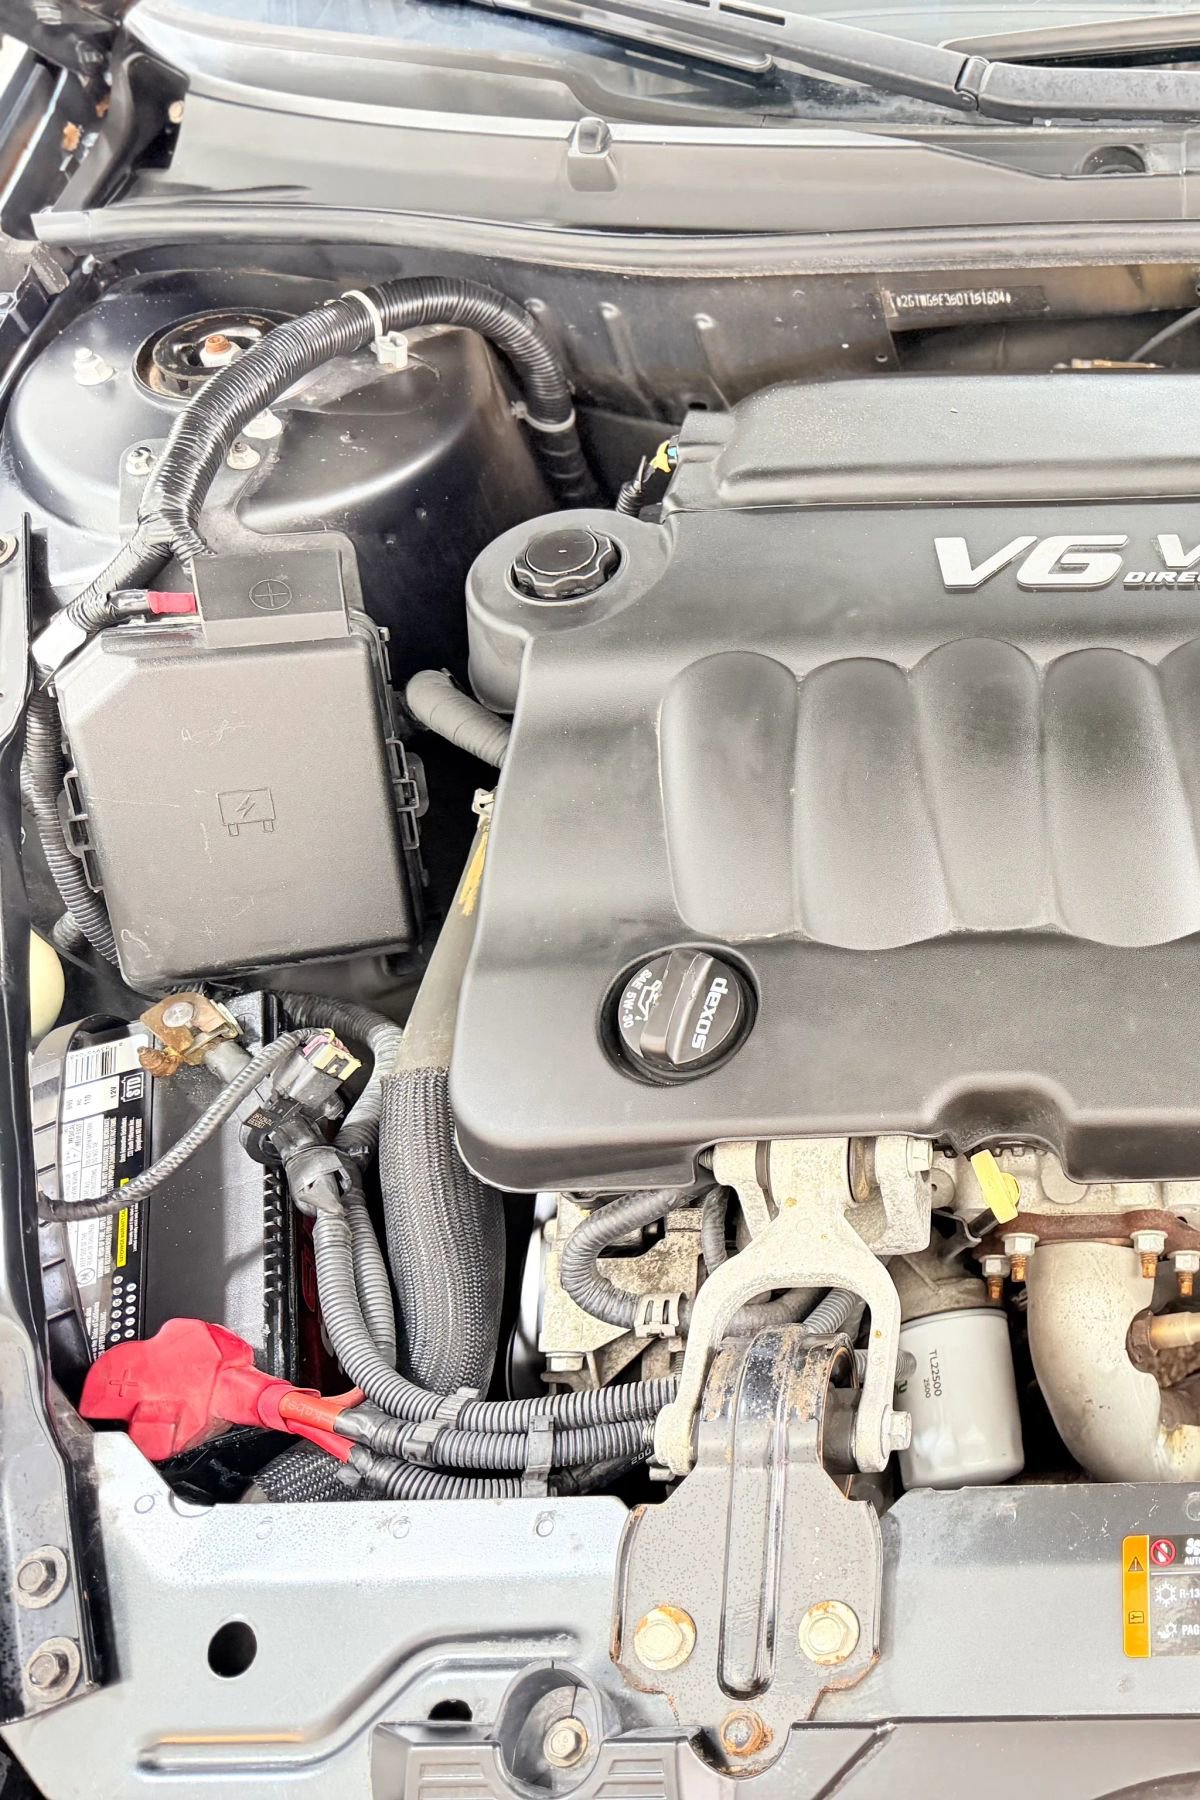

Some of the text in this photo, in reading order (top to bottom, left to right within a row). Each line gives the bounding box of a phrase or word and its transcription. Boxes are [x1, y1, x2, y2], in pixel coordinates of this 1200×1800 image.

[934, 535, 1129, 589] V6
[622, 969, 652, 1029] SAE 5W-30
[691, 977, 728, 1053] dexos
[127, 1075, 143, 1098] STD
[923, 1378, 931, 1398] 2500
[929, 1349, 942, 1397] TL22500
[1181, 1624, 1200, 1635] PAG
